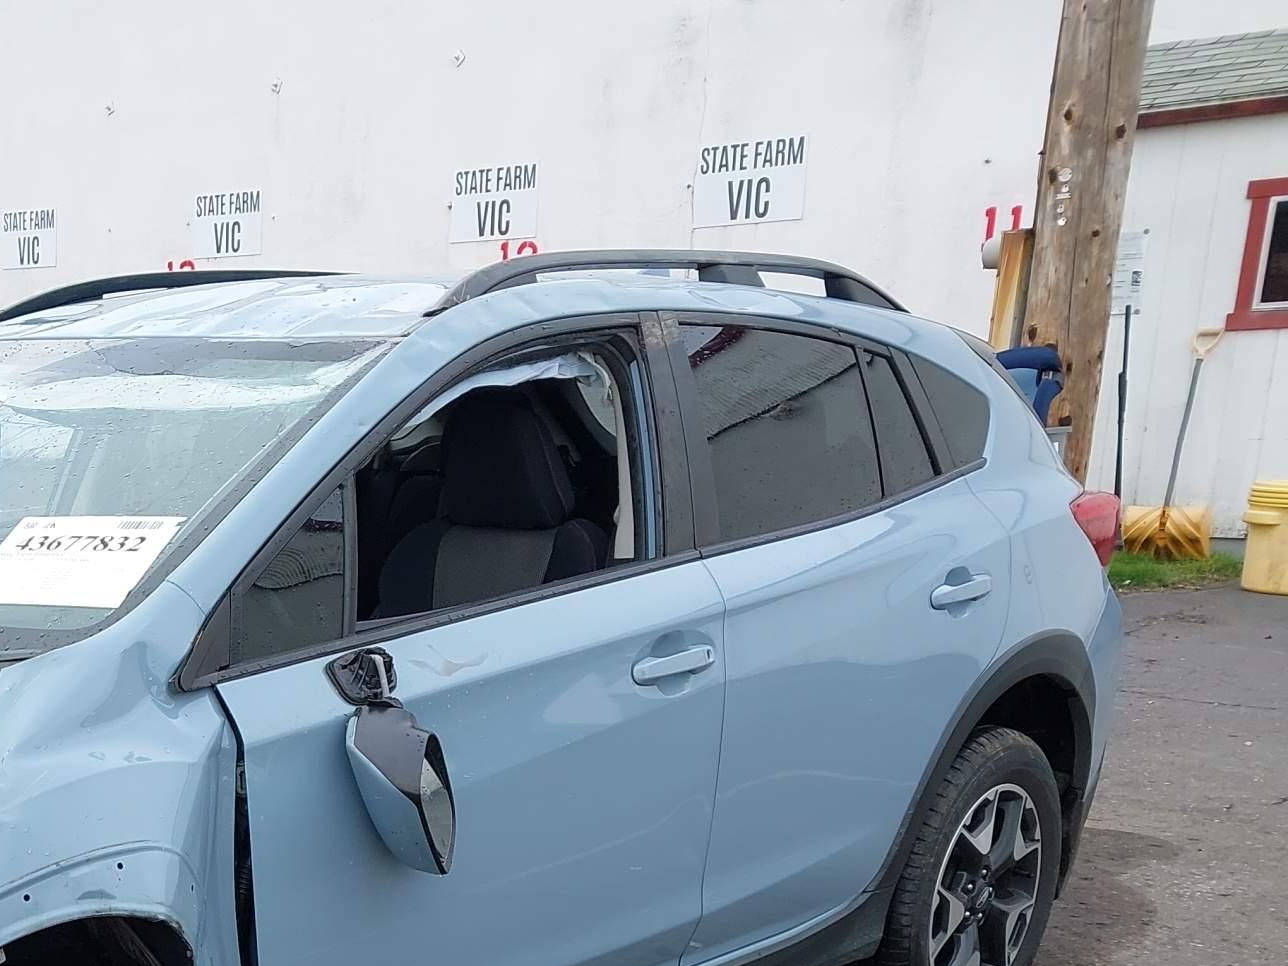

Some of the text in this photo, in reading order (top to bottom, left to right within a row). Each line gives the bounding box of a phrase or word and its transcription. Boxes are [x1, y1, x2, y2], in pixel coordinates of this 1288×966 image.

[700, 136, 805, 175] STATE FARM
[455, 163, 536, 196] STATE FARM
[196, 190, 260, 217] STATE FARM
[727, 177, 771, 220] VIC
[3, 208, 55, 232] STATE FARM
[476, 199, 511, 237] VIC
[17, 235, 40, 265] VIC
[214, 220, 241, 254] VIC
[15, 535, 147, 552] 43677832
